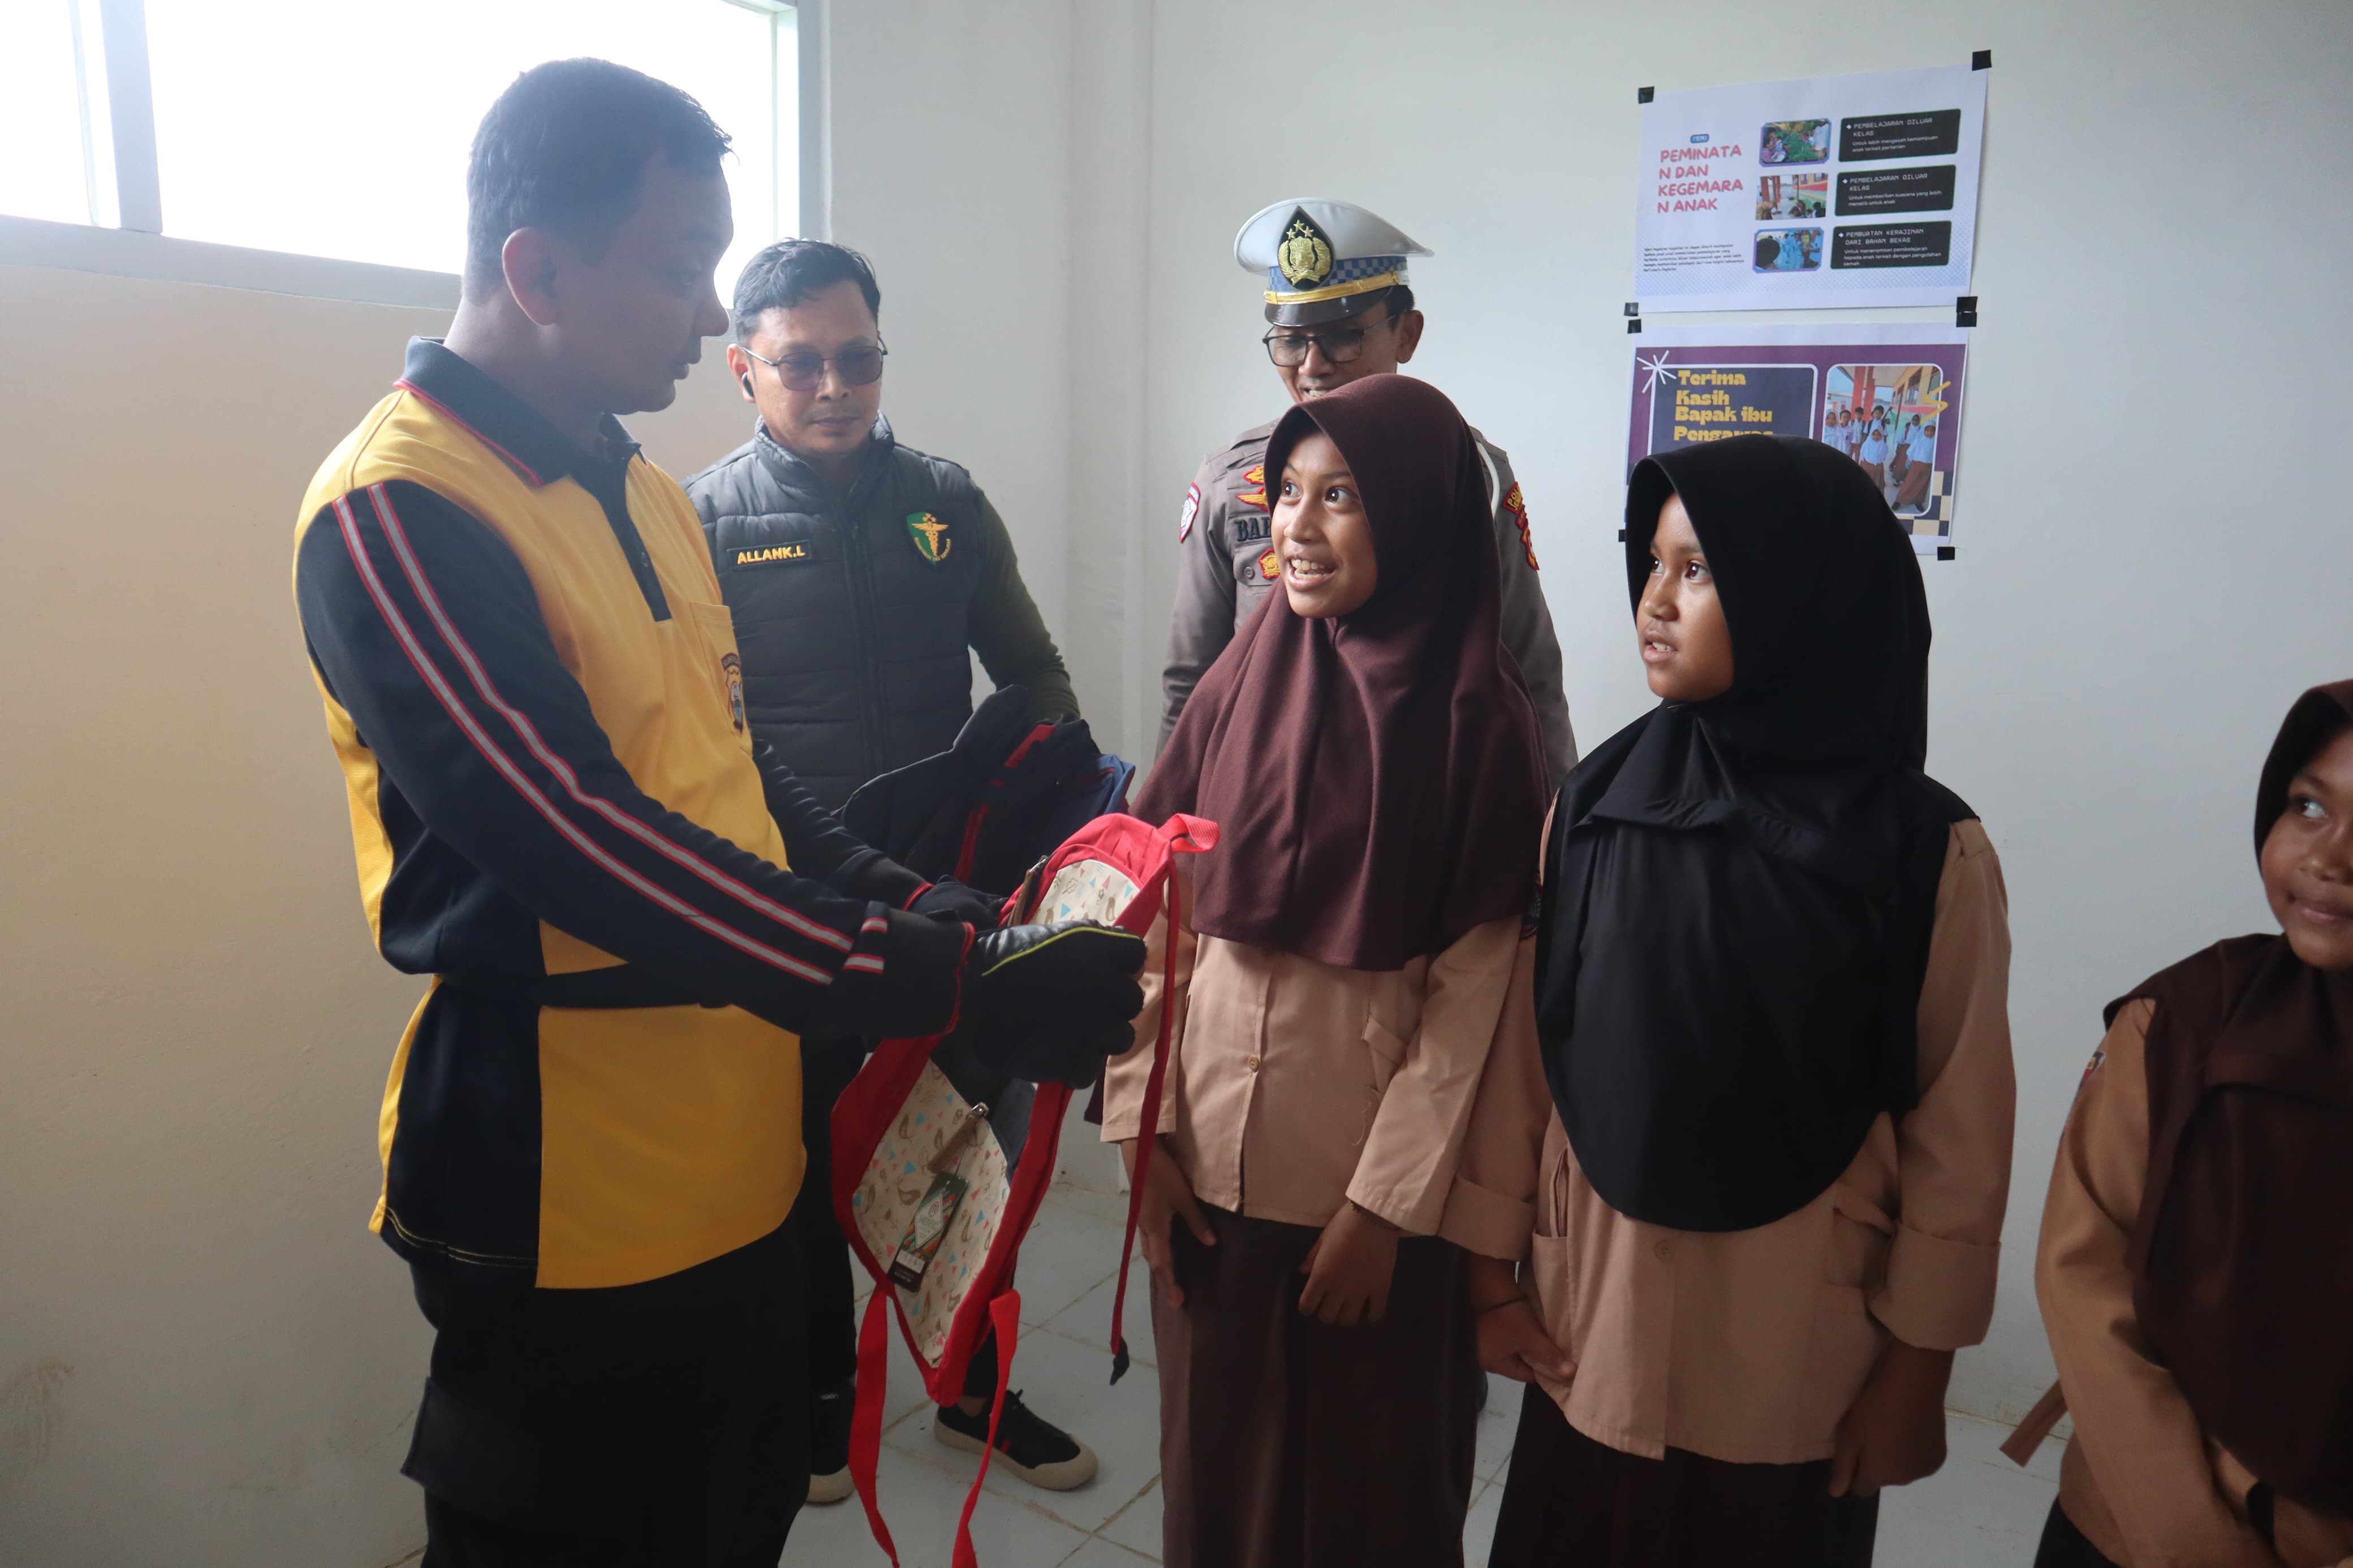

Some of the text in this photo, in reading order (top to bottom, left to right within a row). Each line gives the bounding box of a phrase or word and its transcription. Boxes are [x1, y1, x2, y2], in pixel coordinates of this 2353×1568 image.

[1854, 120, 1903, 129] PEMBELAJARAN
[1660, 144, 1742, 163] PEMINATA
[1659, 163, 1709, 180] N DAN
[1850, 175, 1899, 184] PEMBELAJARAN
[1658, 178, 1743, 196] KEGEMARA
[1657, 198, 1718, 214] N ANAK
[1678, 369, 1747, 386] Terima
[1676, 390, 1730, 405] Kasih
[1675, 405, 1773, 425] Bapak ibu
[738, 545, 805, 564] ALLANK.L
